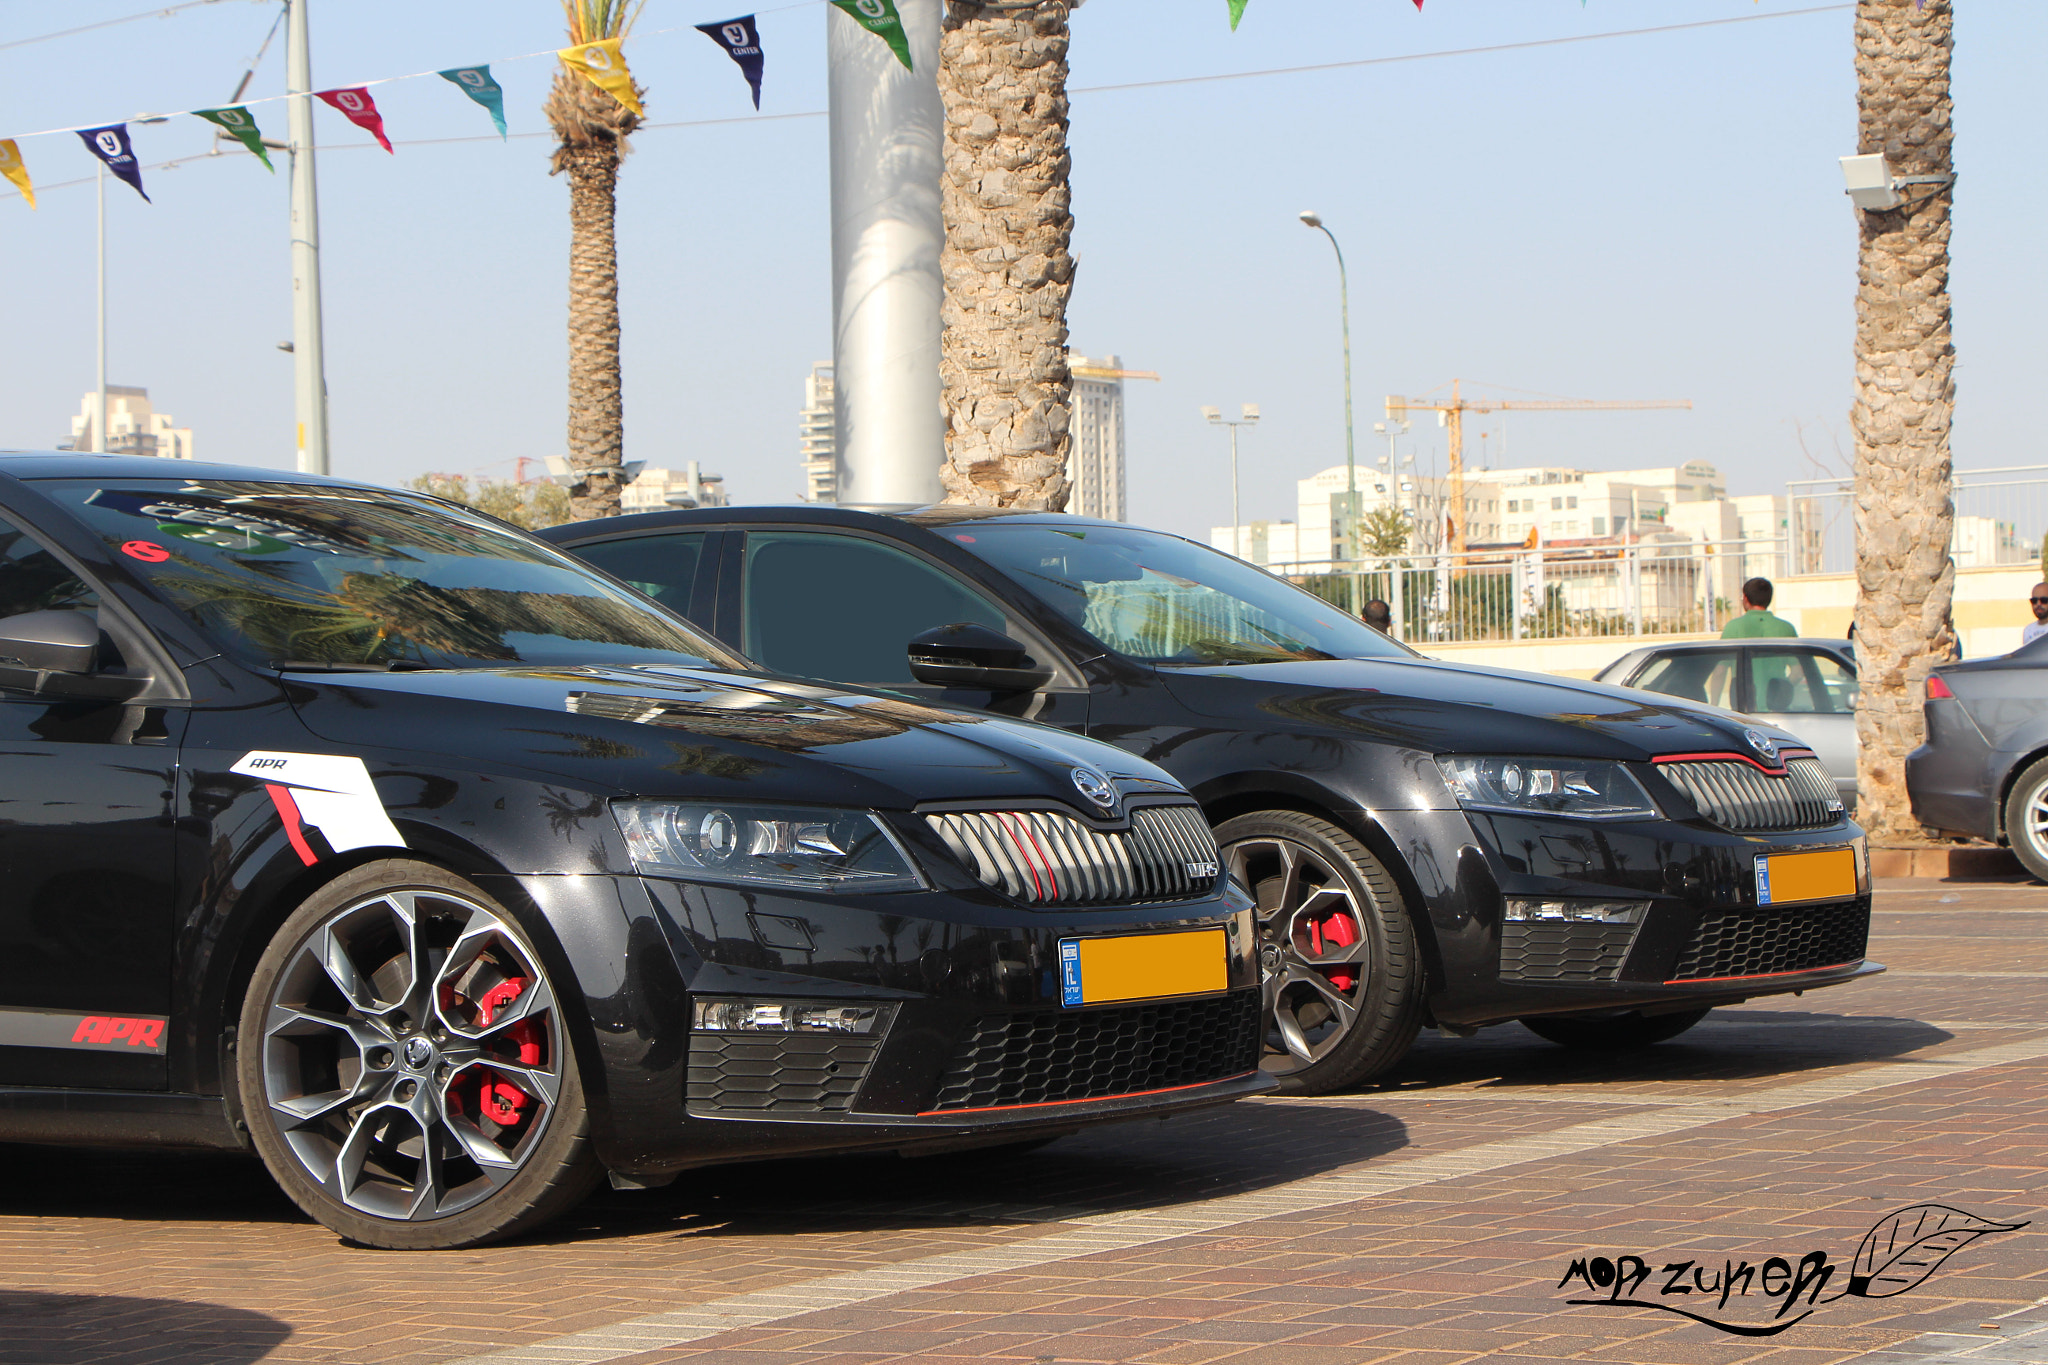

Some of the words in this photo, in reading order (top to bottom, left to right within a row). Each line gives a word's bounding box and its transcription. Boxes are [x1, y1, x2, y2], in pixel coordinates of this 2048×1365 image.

[868, 16, 897, 26] CENTER
[733, 46, 760, 55] CENTER
[107, 154, 133, 165] CENTER
[249, 758, 288, 770] APR
[71, 1016, 165, 1048] APR
